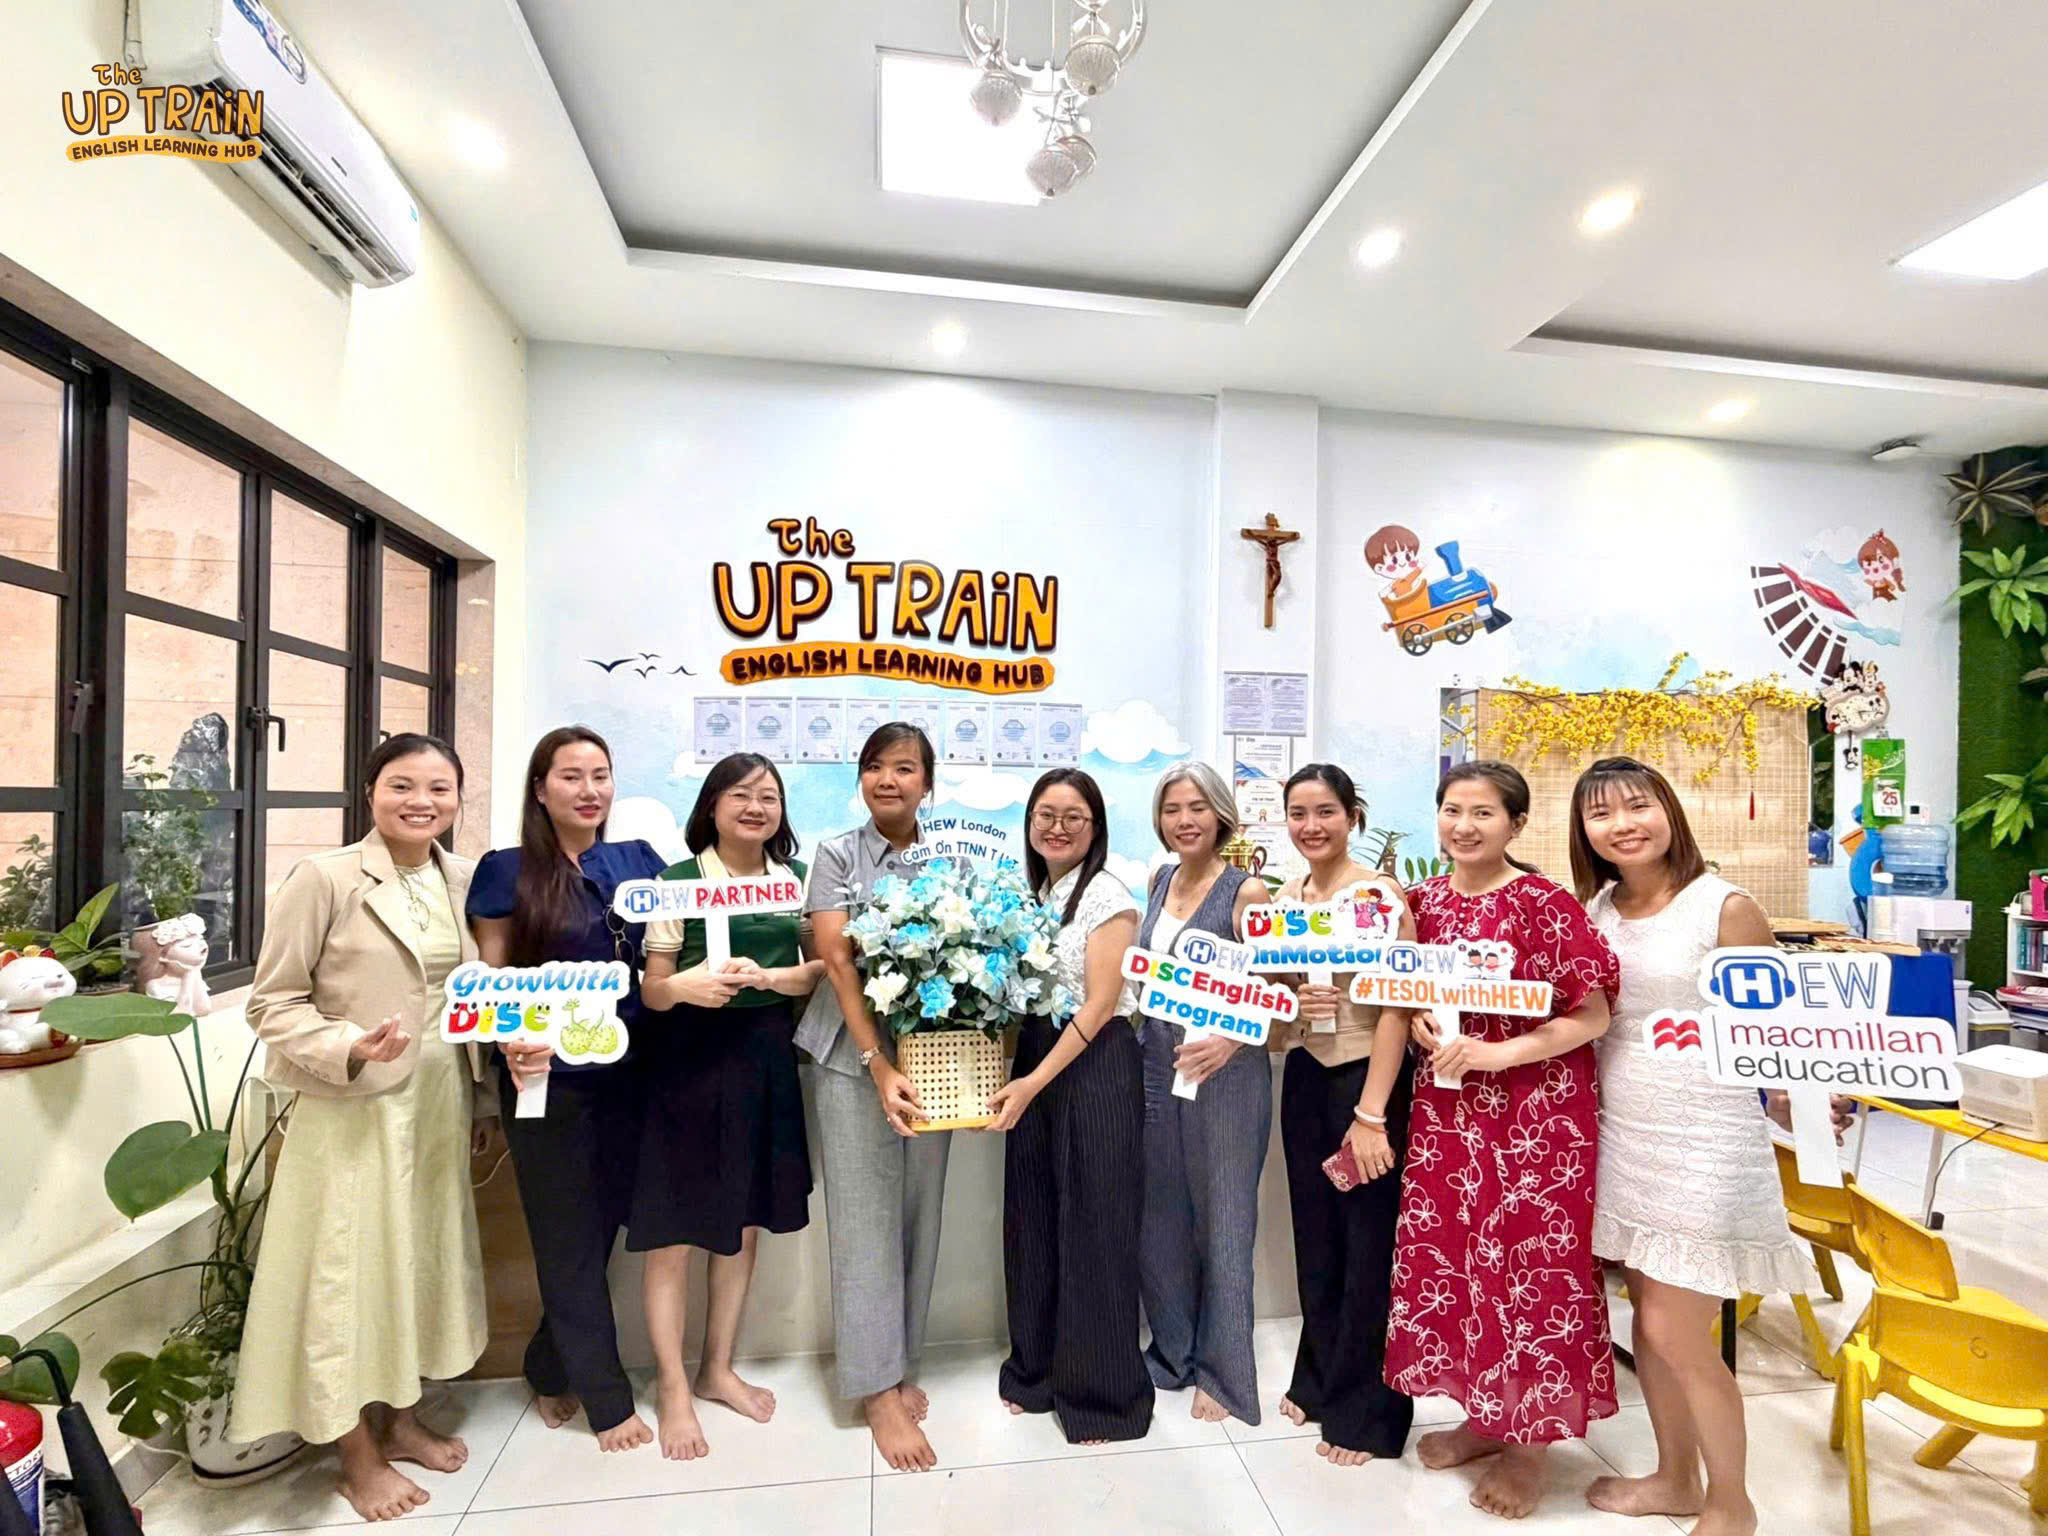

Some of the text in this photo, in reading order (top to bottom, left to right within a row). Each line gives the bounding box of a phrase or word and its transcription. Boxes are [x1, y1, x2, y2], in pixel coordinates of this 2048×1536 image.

[767, 516, 856, 558] The
[713, 561, 833, 640] UP
[731, 647, 1045, 687] ENGLISH LEARNING HUB
[1882, 791, 1898, 806] 25
[922, 818, 1007, 841] HEW London
[625, 881, 799, 913] HEW PARTNER
[1184, 936, 1250, 974] HEW
[1386, 946, 1456, 974] HEW
[1130, 954, 1293, 1015] DISCEnglish
[1355, 977, 1548, 1012] #TESOLwithHEW
[1709, 955, 1879, 1010] HEW
[1148, 990, 1263, 1039] Program
[1730, 1021, 1944, 1055] macmillan
[1734, 1052, 1950, 1091] education
